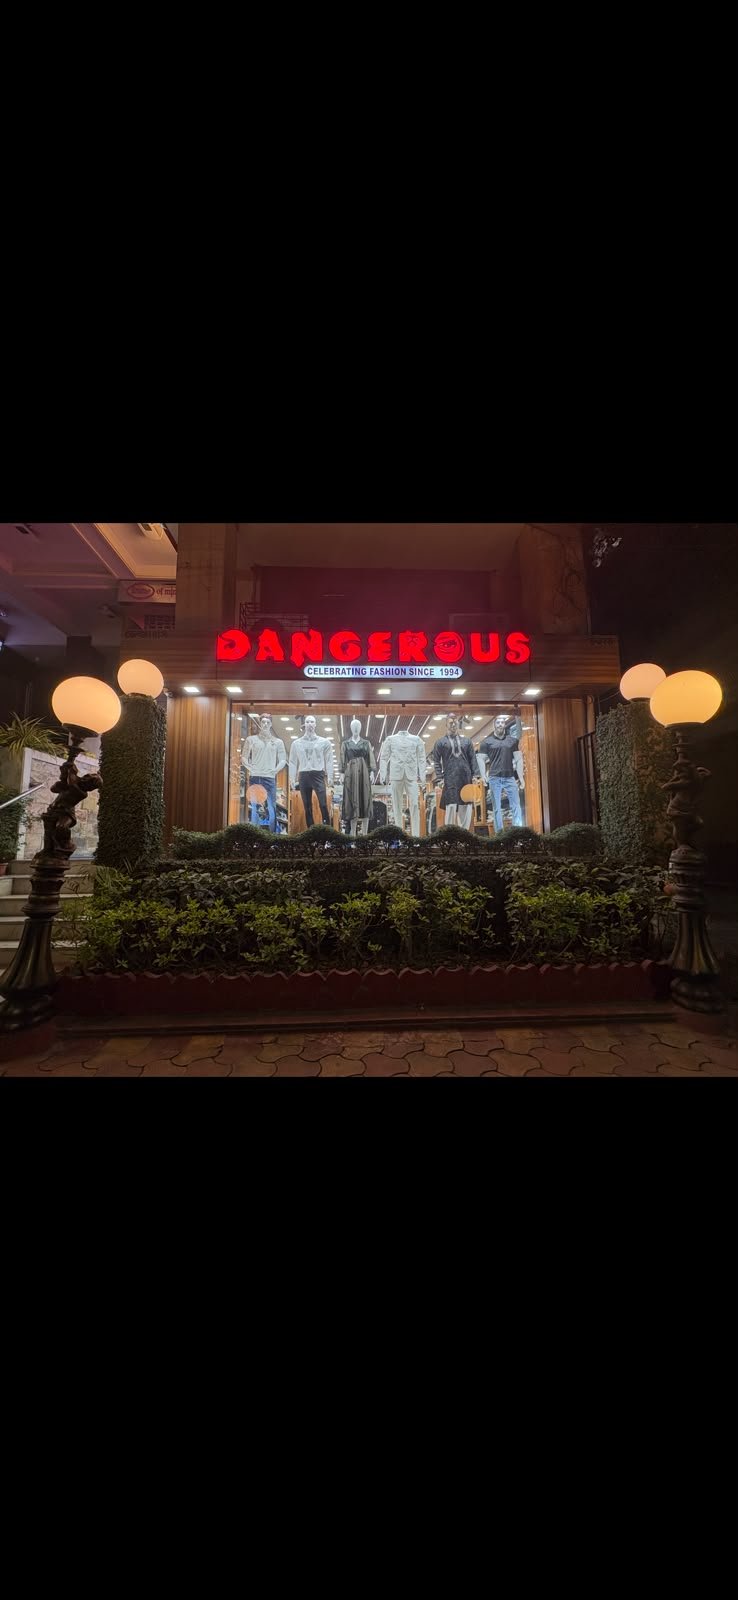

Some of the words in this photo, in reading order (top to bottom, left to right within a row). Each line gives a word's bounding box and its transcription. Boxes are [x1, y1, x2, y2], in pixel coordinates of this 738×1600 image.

[217, 628, 531, 667] DANGEROUS
[307, 667, 367, 676] CELEBRATING
[369, 667, 407, 676] FASHION
[408, 667, 435, 676] SINCE
[439, 667, 460, 676] 1994
